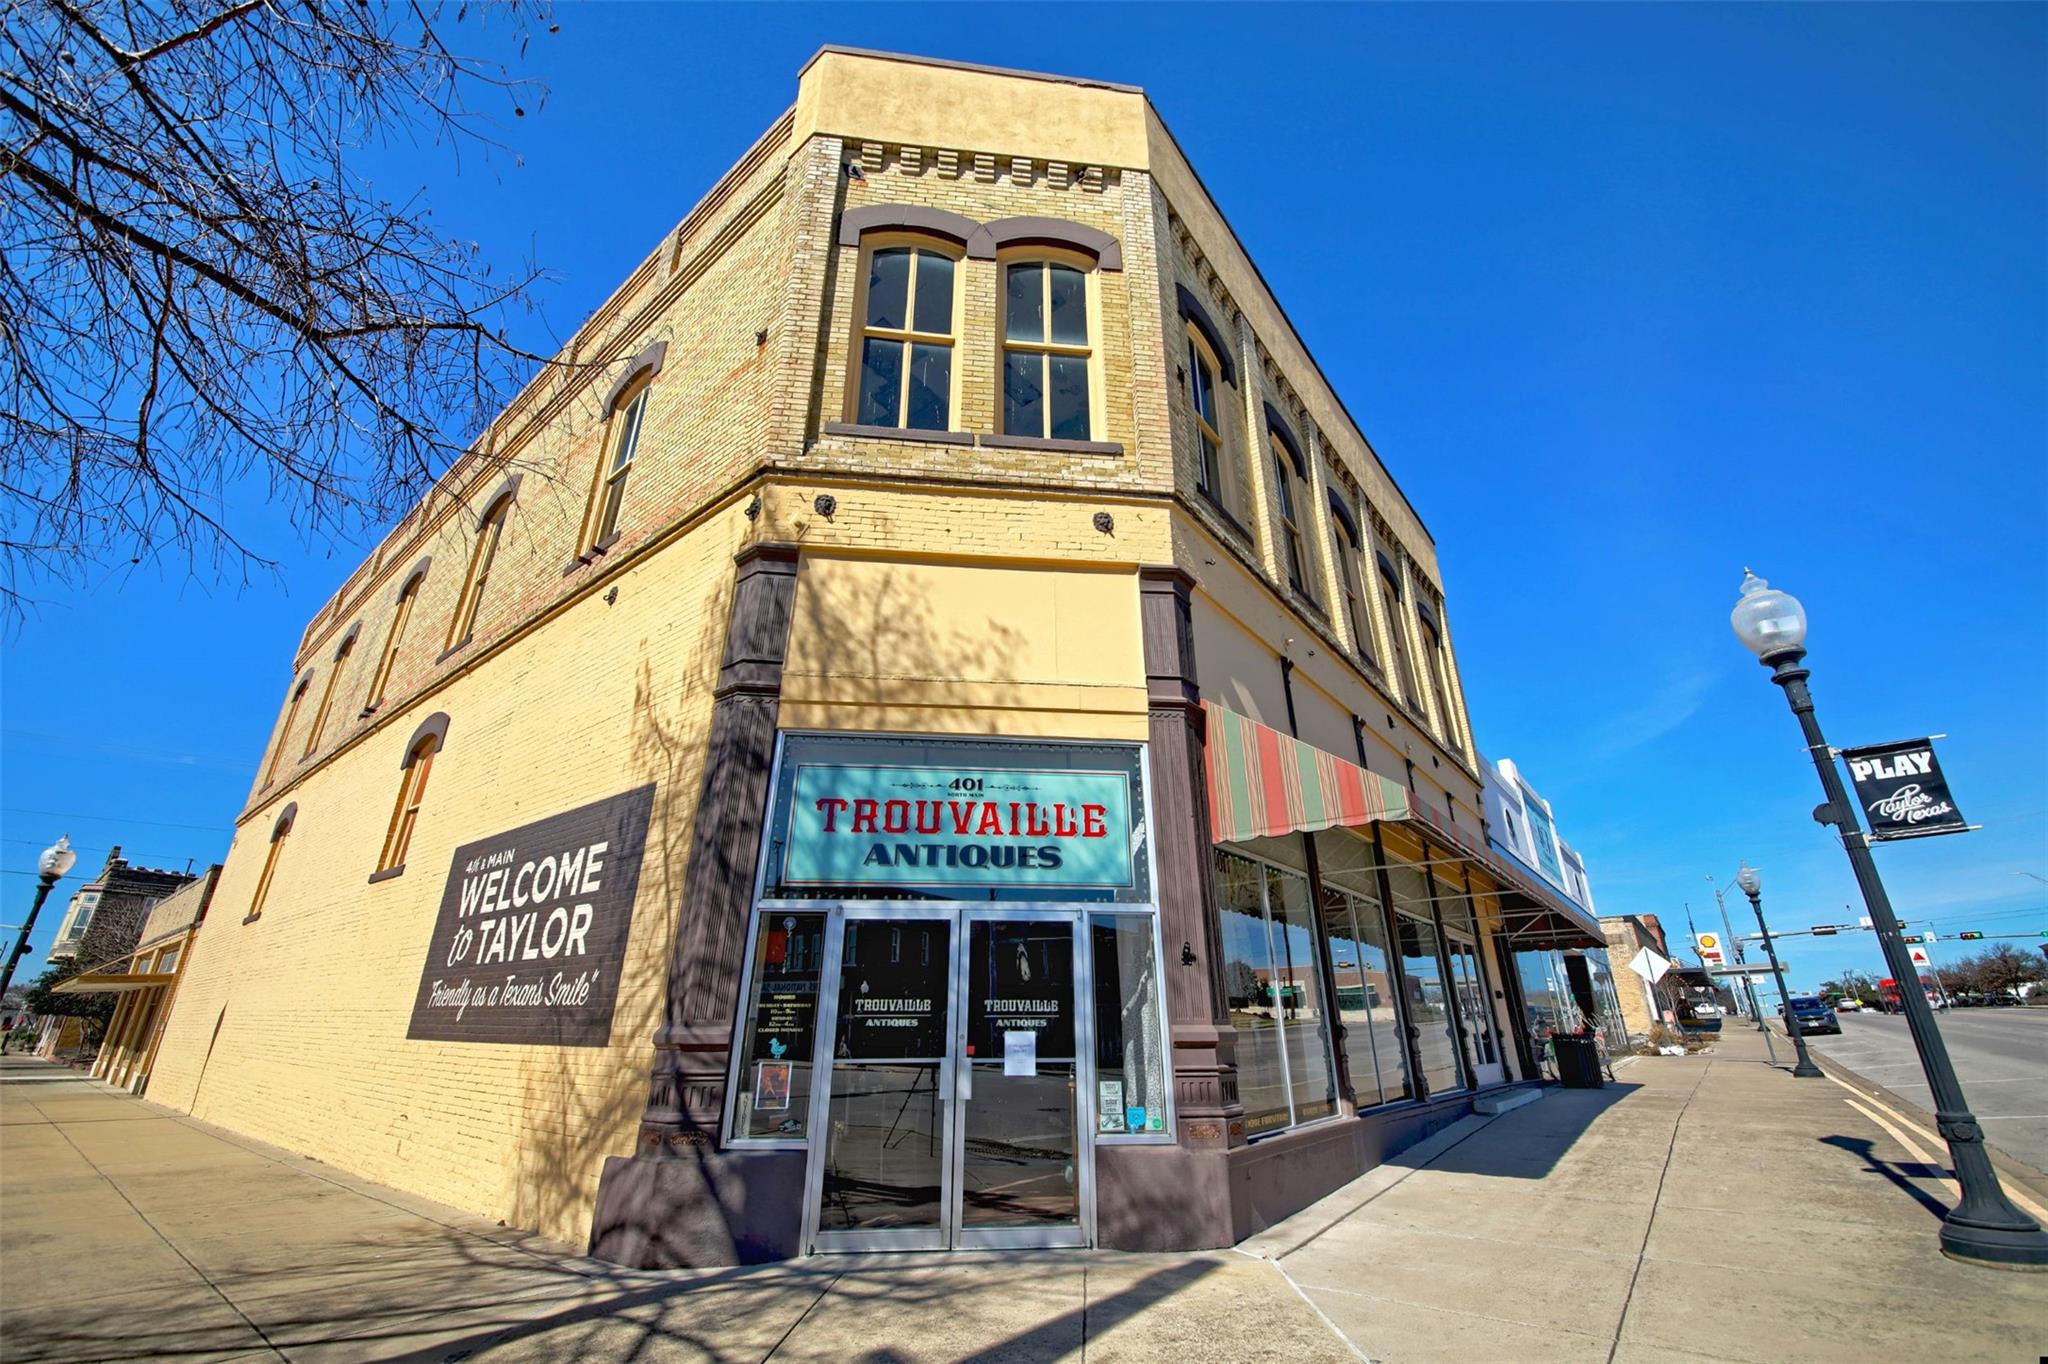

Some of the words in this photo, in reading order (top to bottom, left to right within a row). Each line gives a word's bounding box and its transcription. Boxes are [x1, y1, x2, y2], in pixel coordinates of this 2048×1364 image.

[1850, 751, 1932, 782] PLAY
[948, 777, 983, 791] 401
[1868, 783, 1933, 821] Taylor
[1907, 801, 1953, 824] Texas
[816, 798, 1110, 838] TROUVAILLE
[487, 848, 515, 869] MAIN
[863, 843, 1063, 870] ANTIQUES
[459, 841, 609, 918] WELCOME
[447, 924, 473, 967] to
[475, 903, 593, 965] TAYLOR
[471, 986, 487, 1006] as
[487, 986, 499, 1006] a
[499, 974, 544, 1007] Texan's
[855, 999, 932, 1012] TROUVAILLE
[984, 999, 1059, 1012] TROUVAILLE
[865, 1019, 919, 1027] ANTIQUES
[995, 1019, 1048, 1027] ANTIQUES
